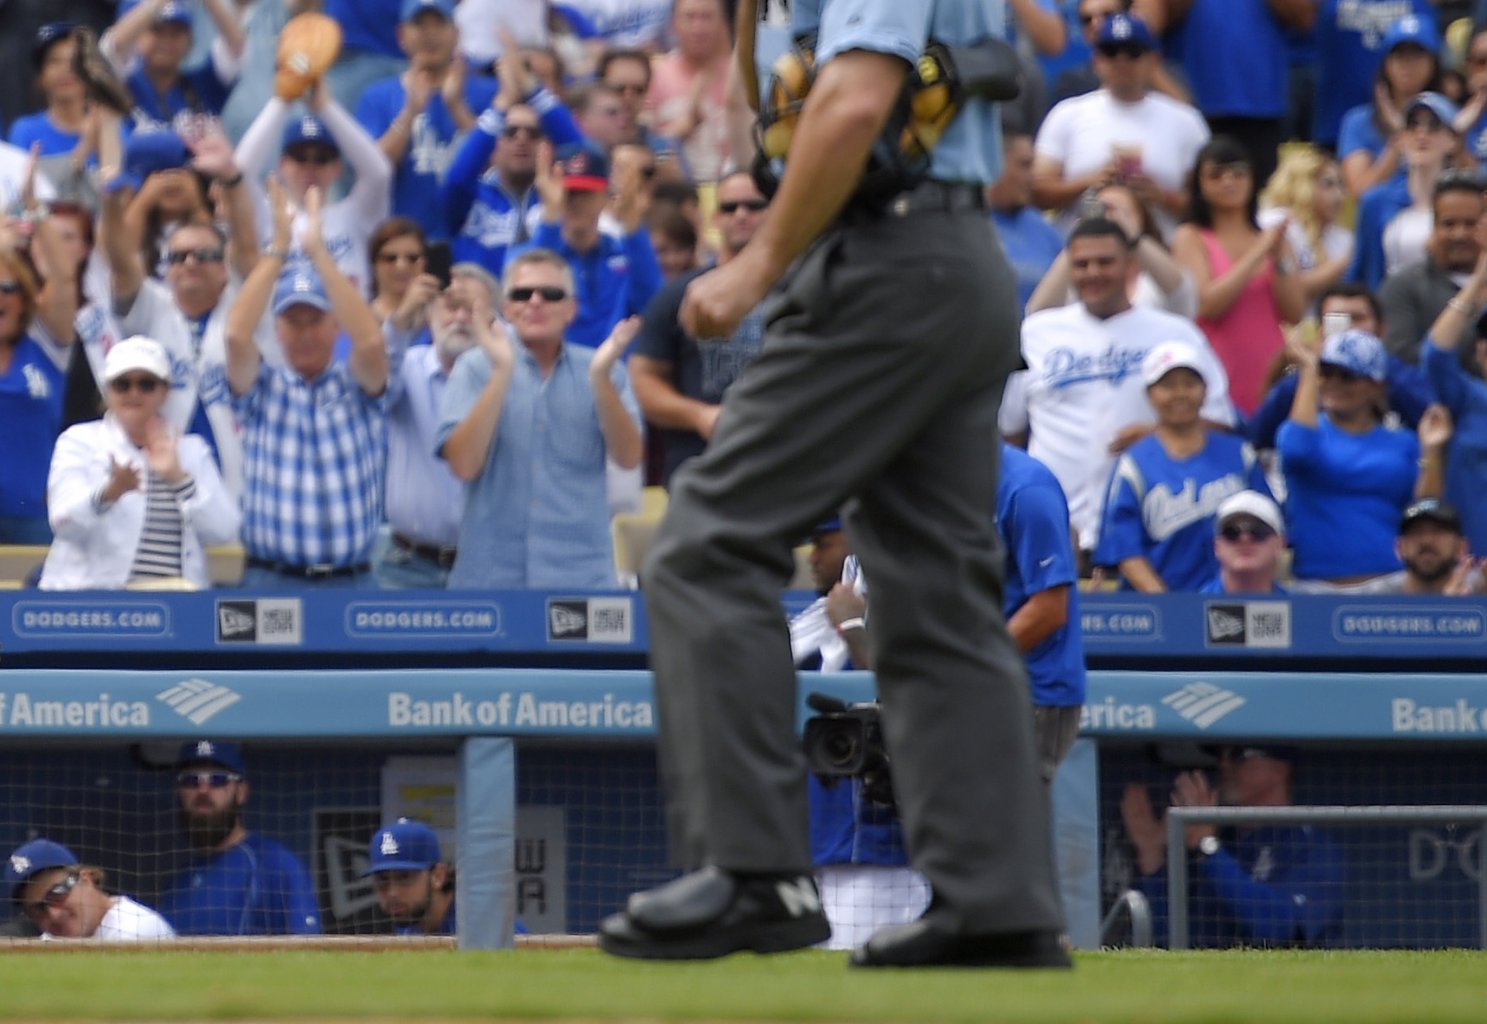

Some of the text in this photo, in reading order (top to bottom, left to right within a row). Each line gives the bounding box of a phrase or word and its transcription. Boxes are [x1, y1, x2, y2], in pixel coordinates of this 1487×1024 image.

[23, 612, 161, 627] DODGERS.COM
[356, 612, 493, 628] DODGERS.COM
[1343, 615, 1480, 633] DODGERS.COM
[11, 693, 150, 726] America
[387, 692, 654, 726] Bank of America
[1079, 696, 1156, 729] erica
[1392, 697, 1470, 733] Bank
